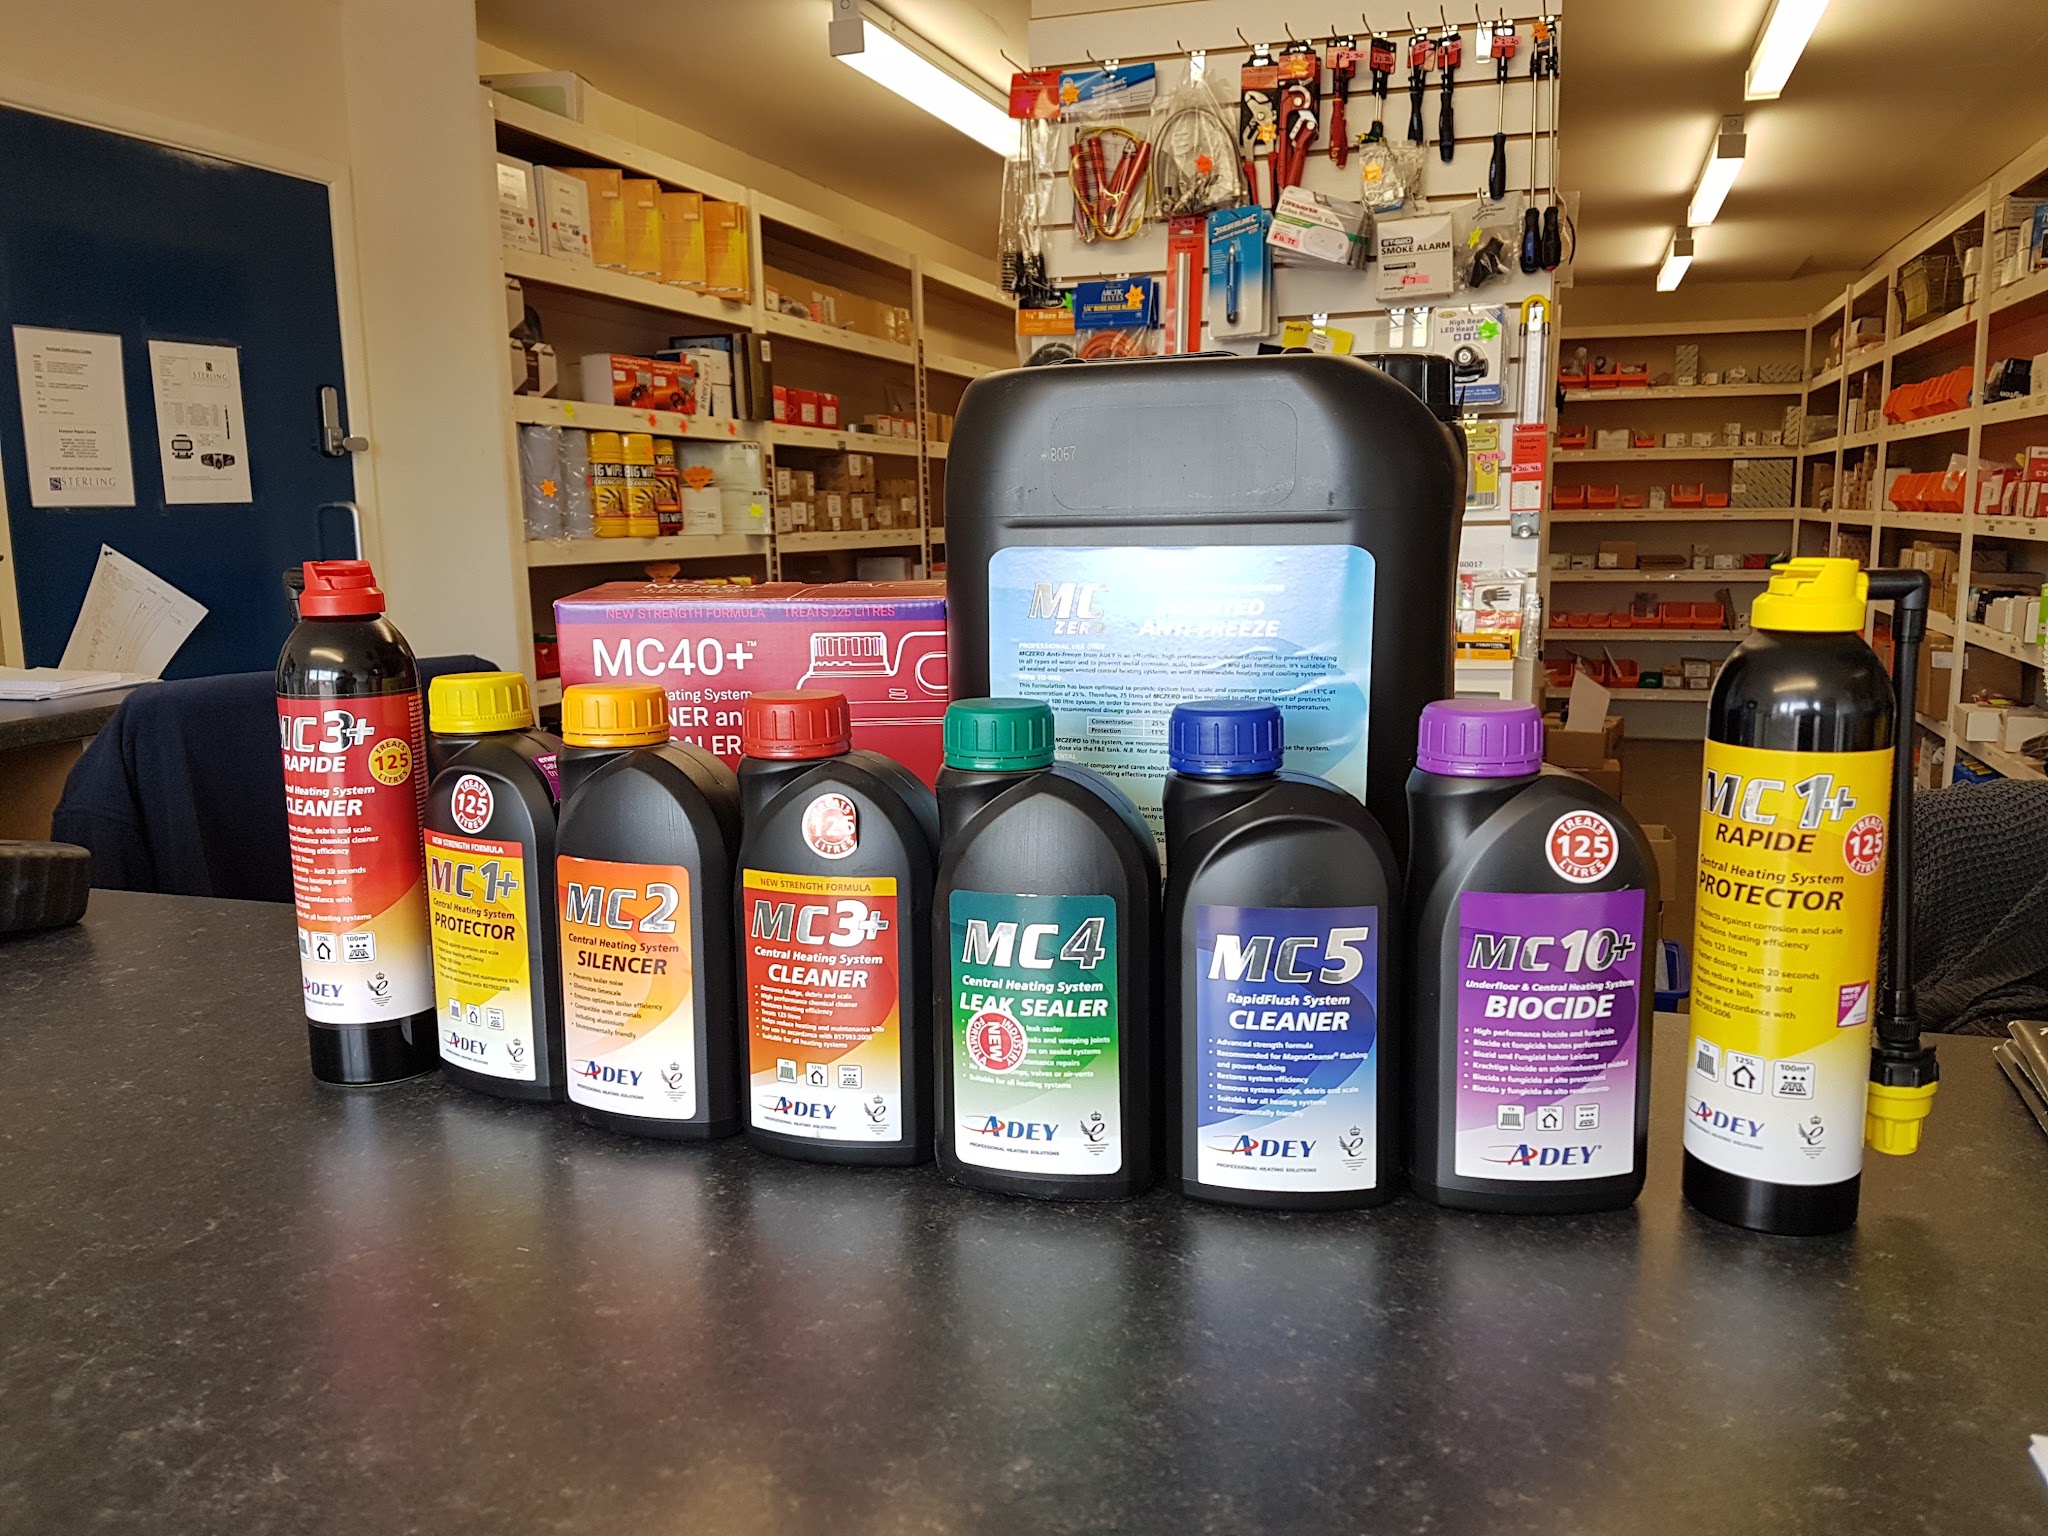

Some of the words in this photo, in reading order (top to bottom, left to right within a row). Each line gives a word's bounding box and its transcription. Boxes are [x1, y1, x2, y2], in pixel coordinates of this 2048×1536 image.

[1381, 245, 1414, 255] SMOKE
[1417, 242, 1450, 252] ALARM
[62, 476, 116, 487] STERLING
[1028, 582, 1110, 619] MC
[606, 608, 634, 619] NEW
[638, 608, 703, 619] STRENGTH
[706, 608, 766, 618] FORMULA
[785, 606, 828, 617] TREATS
[832, 607, 850, 617] 125
[855, 606, 895, 617] LITRES
[1053, 620, 1106, 635] ZERO
[1276, 670, 1300, 678] cooling
[375, 742, 406, 754] TREATS
[284, 756, 346, 773] RAPIDE
[374, 754, 409, 771] 125
[378, 770, 408, 783] LITRES
[294, 785, 330, 798] Heating
[333, 786, 375, 798] System
[460, 780, 487, 796] TREATS
[286, 796, 363, 817] CLEANER
[457, 793, 487, 816] 125
[457, 812, 483, 829] LITRES
[811, 815, 856, 837] 125
[1559, 815, 1606, 835] TREATS
[1852, 816, 1883, 834] TREATS
[815, 838, 854, 854] LITRES
[1556, 836, 1610, 859] 125
[1716, 823, 1816, 853] RAPIDE
[1849, 832, 1884, 857] 125
[471, 843, 504, 854] FORMULA
[1559, 858, 1606, 878] LITRES
[1700, 853, 1728, 873] Central
[1730, 865, 1786, 884] Heating
[1790, 872, 1845, 886] System
[760, 878, 777, 887] NEW
[780, 880, 823, 891] STRENGTH
[826, 882, 871, 892] FORMULA
[1699, 871, 1844, 911] PROTECTOR
[433, 897, 452, 910] Central
[454, 903, 481, 917] Heating
[484, 909, 515, 920] System
[565, 882, 679, 933] MC2
[435, 912, 515, 941] PROTECTOR
[751, 899, 889, 947] MC3+
[1723, 915, 1751, 928] against
[1753, 922, 1799, 935] corrosion
[1801, 926, 1819, 935] and
[1821, 926, 1843, 935] scale
[568, 933, 597, 946] Central
[600, 939, 636, 953] Heating
[640, 943, 679, 953] System
[961, 917, 1106, 970] MC4
[1728, 931, 1761, 946] heating
[1763, 937, 1810, 952] efficiency
[577, 950, 667, 975] SILENCER
[755, 946, 790, 960] Central
[793, 951, 837, 966] Heating
[839, 954, 883, 966] System
[1207, 927, 1369, 984] MC5
[768, 964, 869, 988] CLEANER
[962, 975, 1003, 989] Central
[1006, 980, 1054, 994] Heating
[1057, 981, 1104, 992] System
[1465, 979, 1520, 991] Underfloor
[1522, 983, 1529, 991] &
[1532, 983, 1567, 993] Central
[1568, 982, 1604, 992] Heating
[1605, 979, 1634, 990] System
[598, 986, 621, 996] limescale
[1226, 992, 1299, 1006] RapidFlush
[1302, 995, 1350, 1008] System
[959, 992, 1014, 1016] LEAK
[1020, 998, 1109, 1018] SEALER
[1484, 993, 1616, 1021] BIOCIDE
[1026, 1025, 1040, 1033] leak
[1042, 1025, 1063, 1033] sealer
[1229, 1009, 1350, 1032] CLEANER
[448, 1032, 487, 1055] ADEY
[615, 1029, 636, 1039] friendly
[969, 1017, 987, 1066] FORMULA
[988, 1021, 1002, 1062] NEW
[1002, 1018, 1024, 1066] INDUSTRY
[1217, 1038, 1251, 1048] Advanced
[1253, 1041, 1283, 1050] strength
[1285, 1041, 1313, 1050] formula
[1217, 1050, 1269, 1060] Recommended
[1270, 1052, 1281, 1060] for
[1340, 1051, 1368, 1060] flushing
[1734, 1055, 1755, 1067] 125L
[584, 1061, 642, 1086] ADEY
[1217, 1061, 1230, 1069] and
[1232, 1063, 1286, 1073] power-flushing
[775, 1096, 837, 1119] ADEY
[982, 1115, 1059, 1141] ADEY
[1694, 1100, 1765, 1138] ADEY
[1232, 1135, 1317, 1158] ADEY
